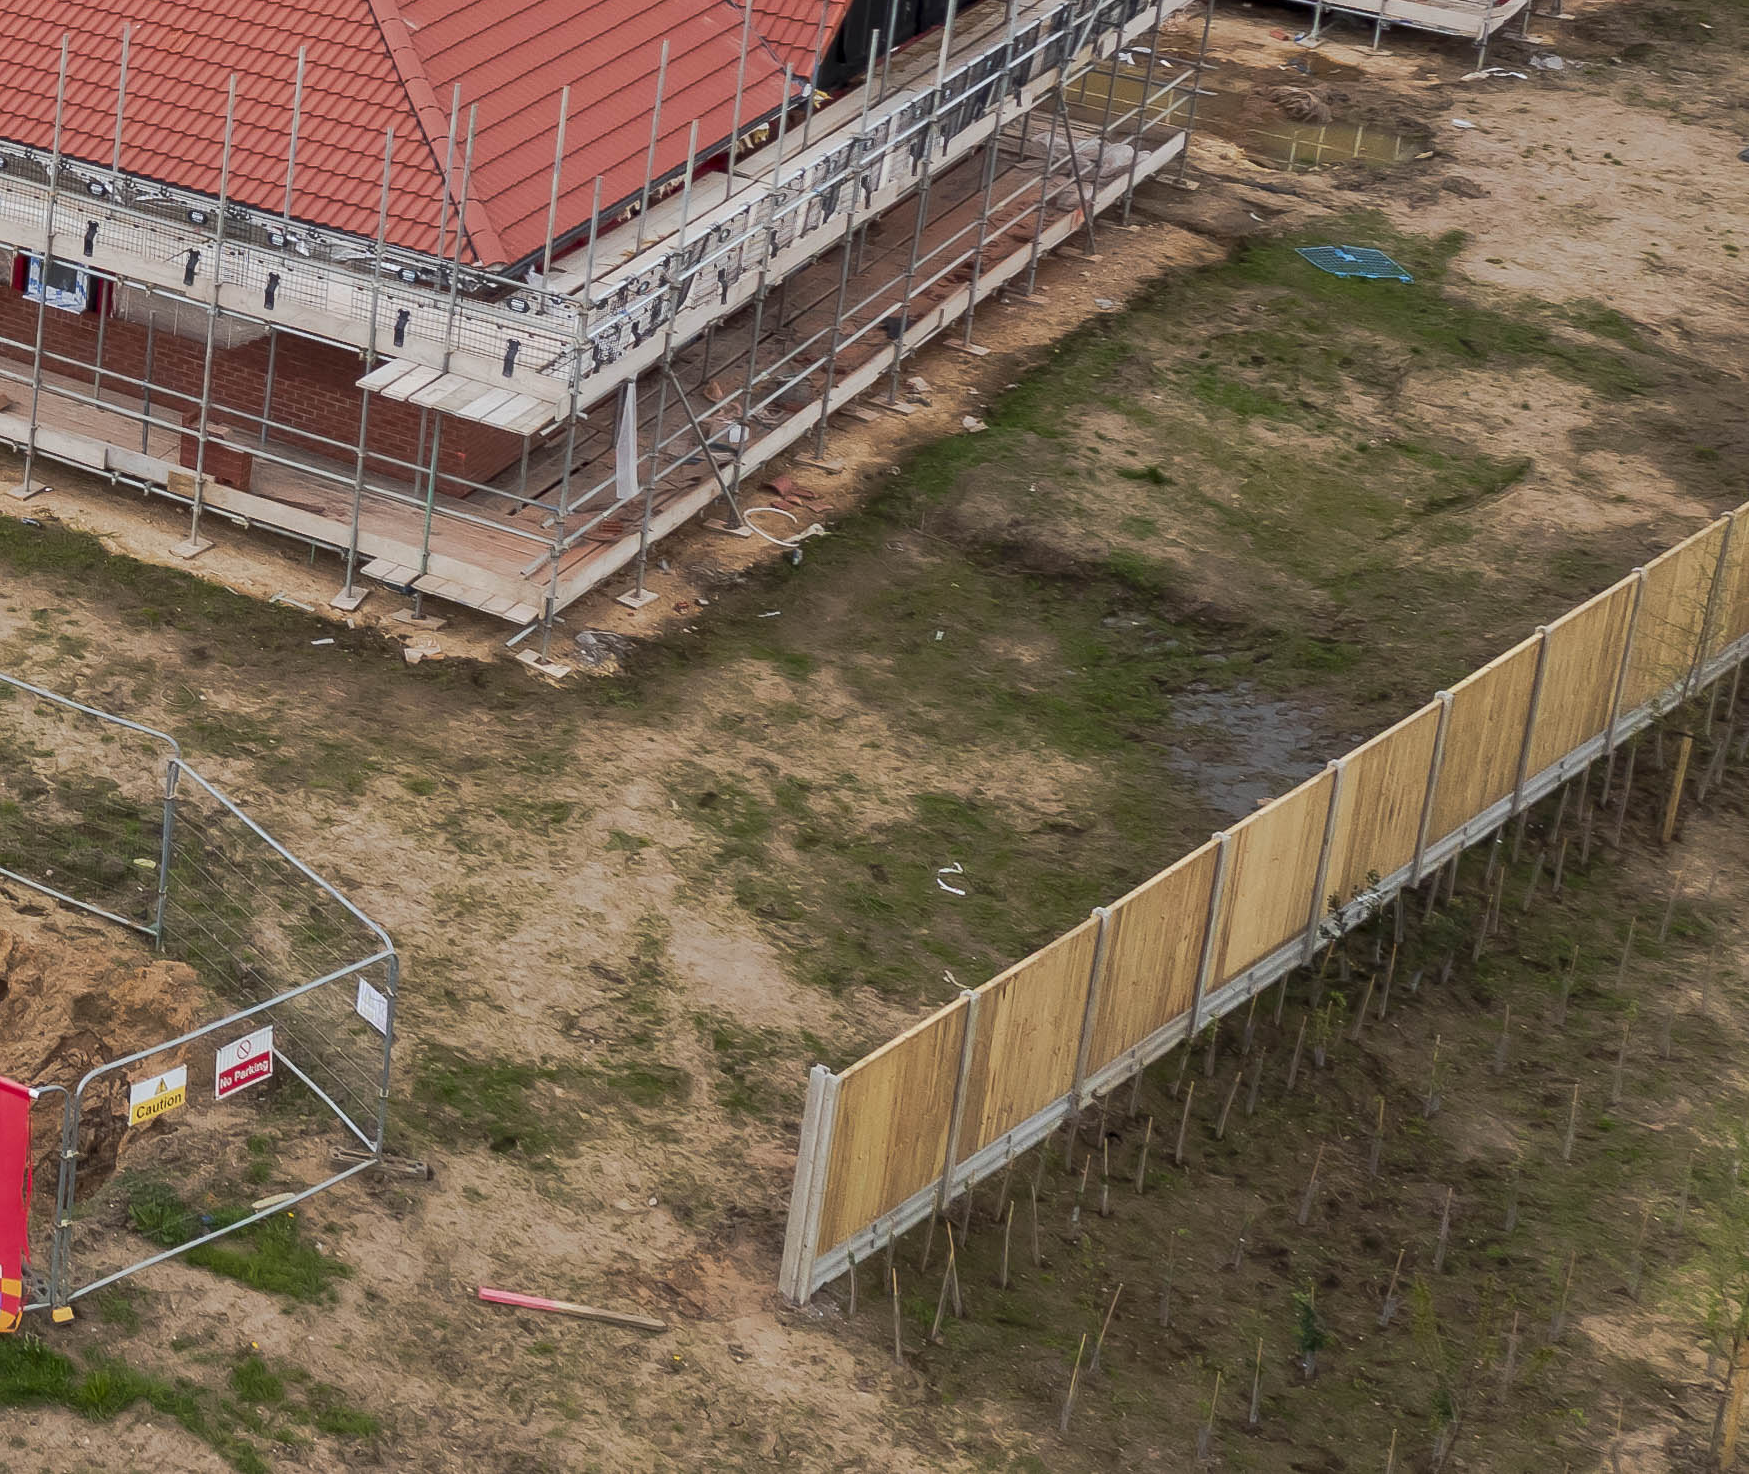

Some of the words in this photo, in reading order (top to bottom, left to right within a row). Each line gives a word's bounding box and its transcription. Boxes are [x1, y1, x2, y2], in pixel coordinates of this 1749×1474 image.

[220, 1077, 232, 1089] No
[234, 1060, 269, 1083] Parking
[136, 1093, 182, 1119] Caution
